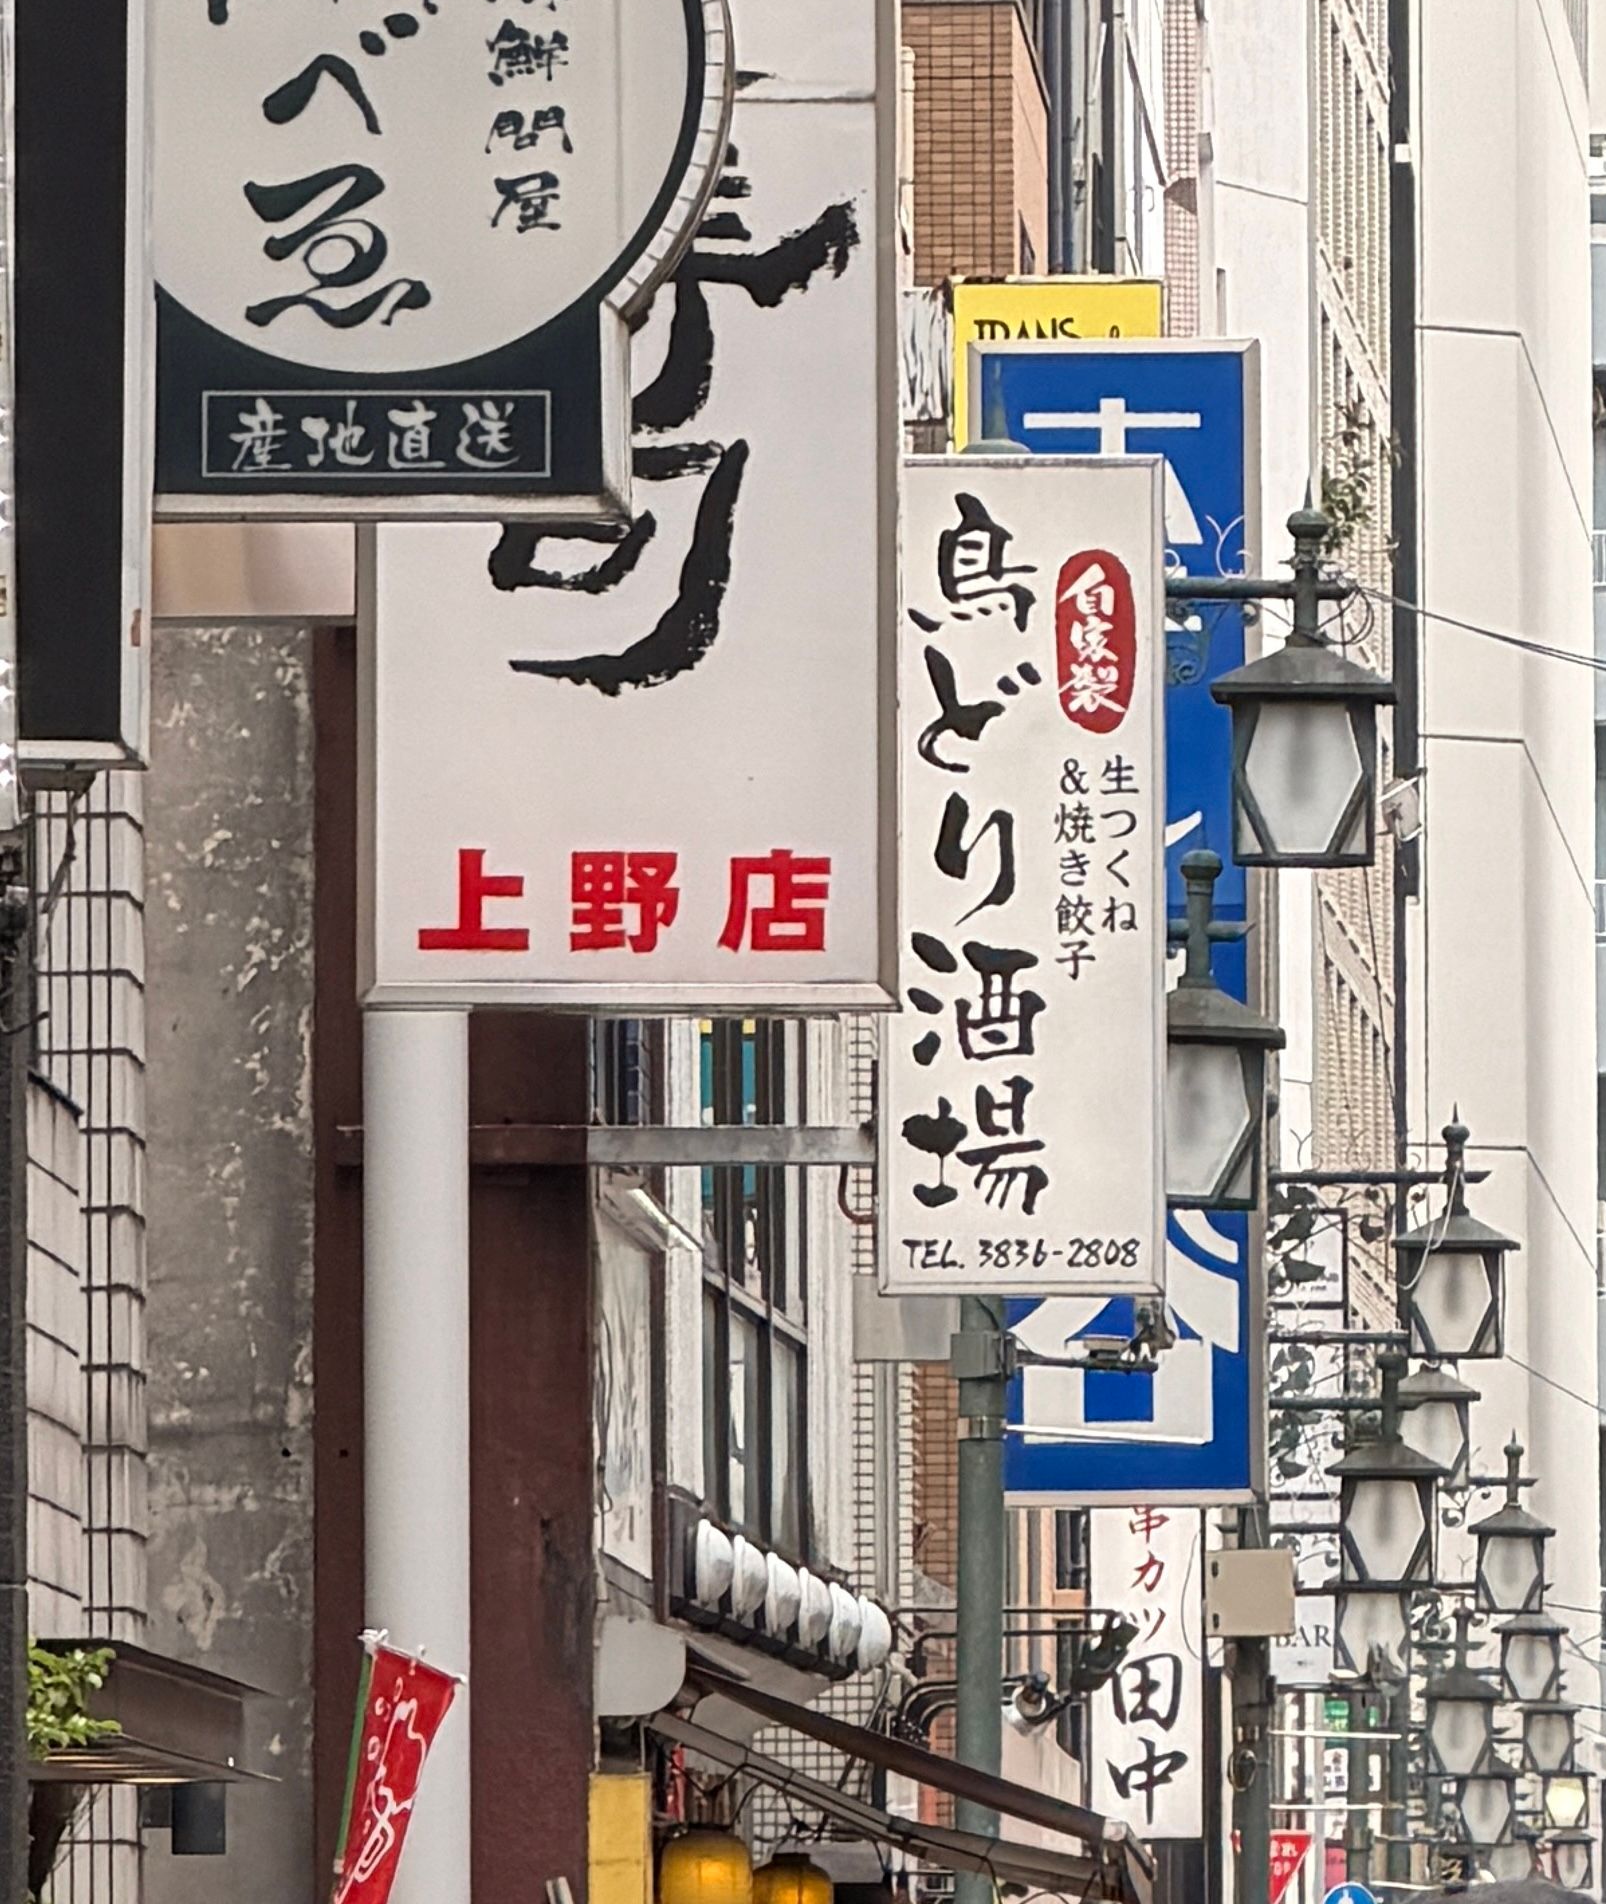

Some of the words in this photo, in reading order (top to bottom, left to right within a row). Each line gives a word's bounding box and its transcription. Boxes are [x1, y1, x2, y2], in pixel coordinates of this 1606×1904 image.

[229, 398, 521, 472] 産地直送
[1057, 565, 1126, 717] 自家製
[418, 848, 831, 953] 上野店
[901, 492, 1047, 1217] 鳥どり酒場
[1098, 755, 1141, 934] 生つくね
[902, 1239, 965, 1270] TEL.
[979, 1237, 1141, 1270] 3836-2808
